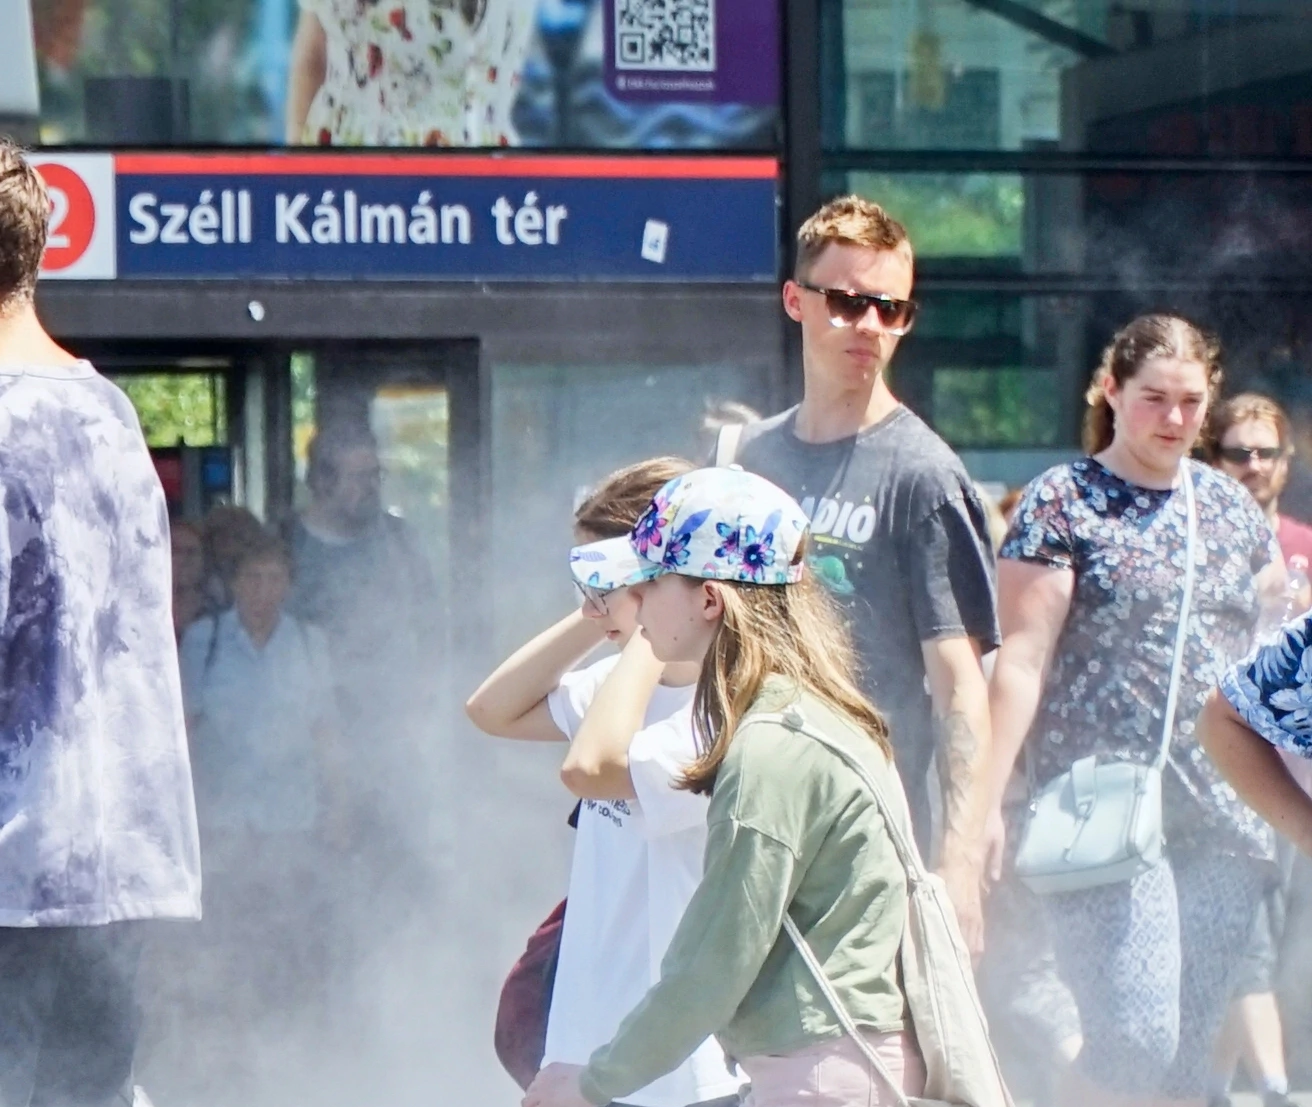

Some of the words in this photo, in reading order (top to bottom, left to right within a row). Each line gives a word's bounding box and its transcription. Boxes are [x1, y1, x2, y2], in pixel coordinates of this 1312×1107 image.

[128, 189, 253, 245] Széll
[275, 189, 472, 245] Kálmán
[491, 189, 569, 246] tér
